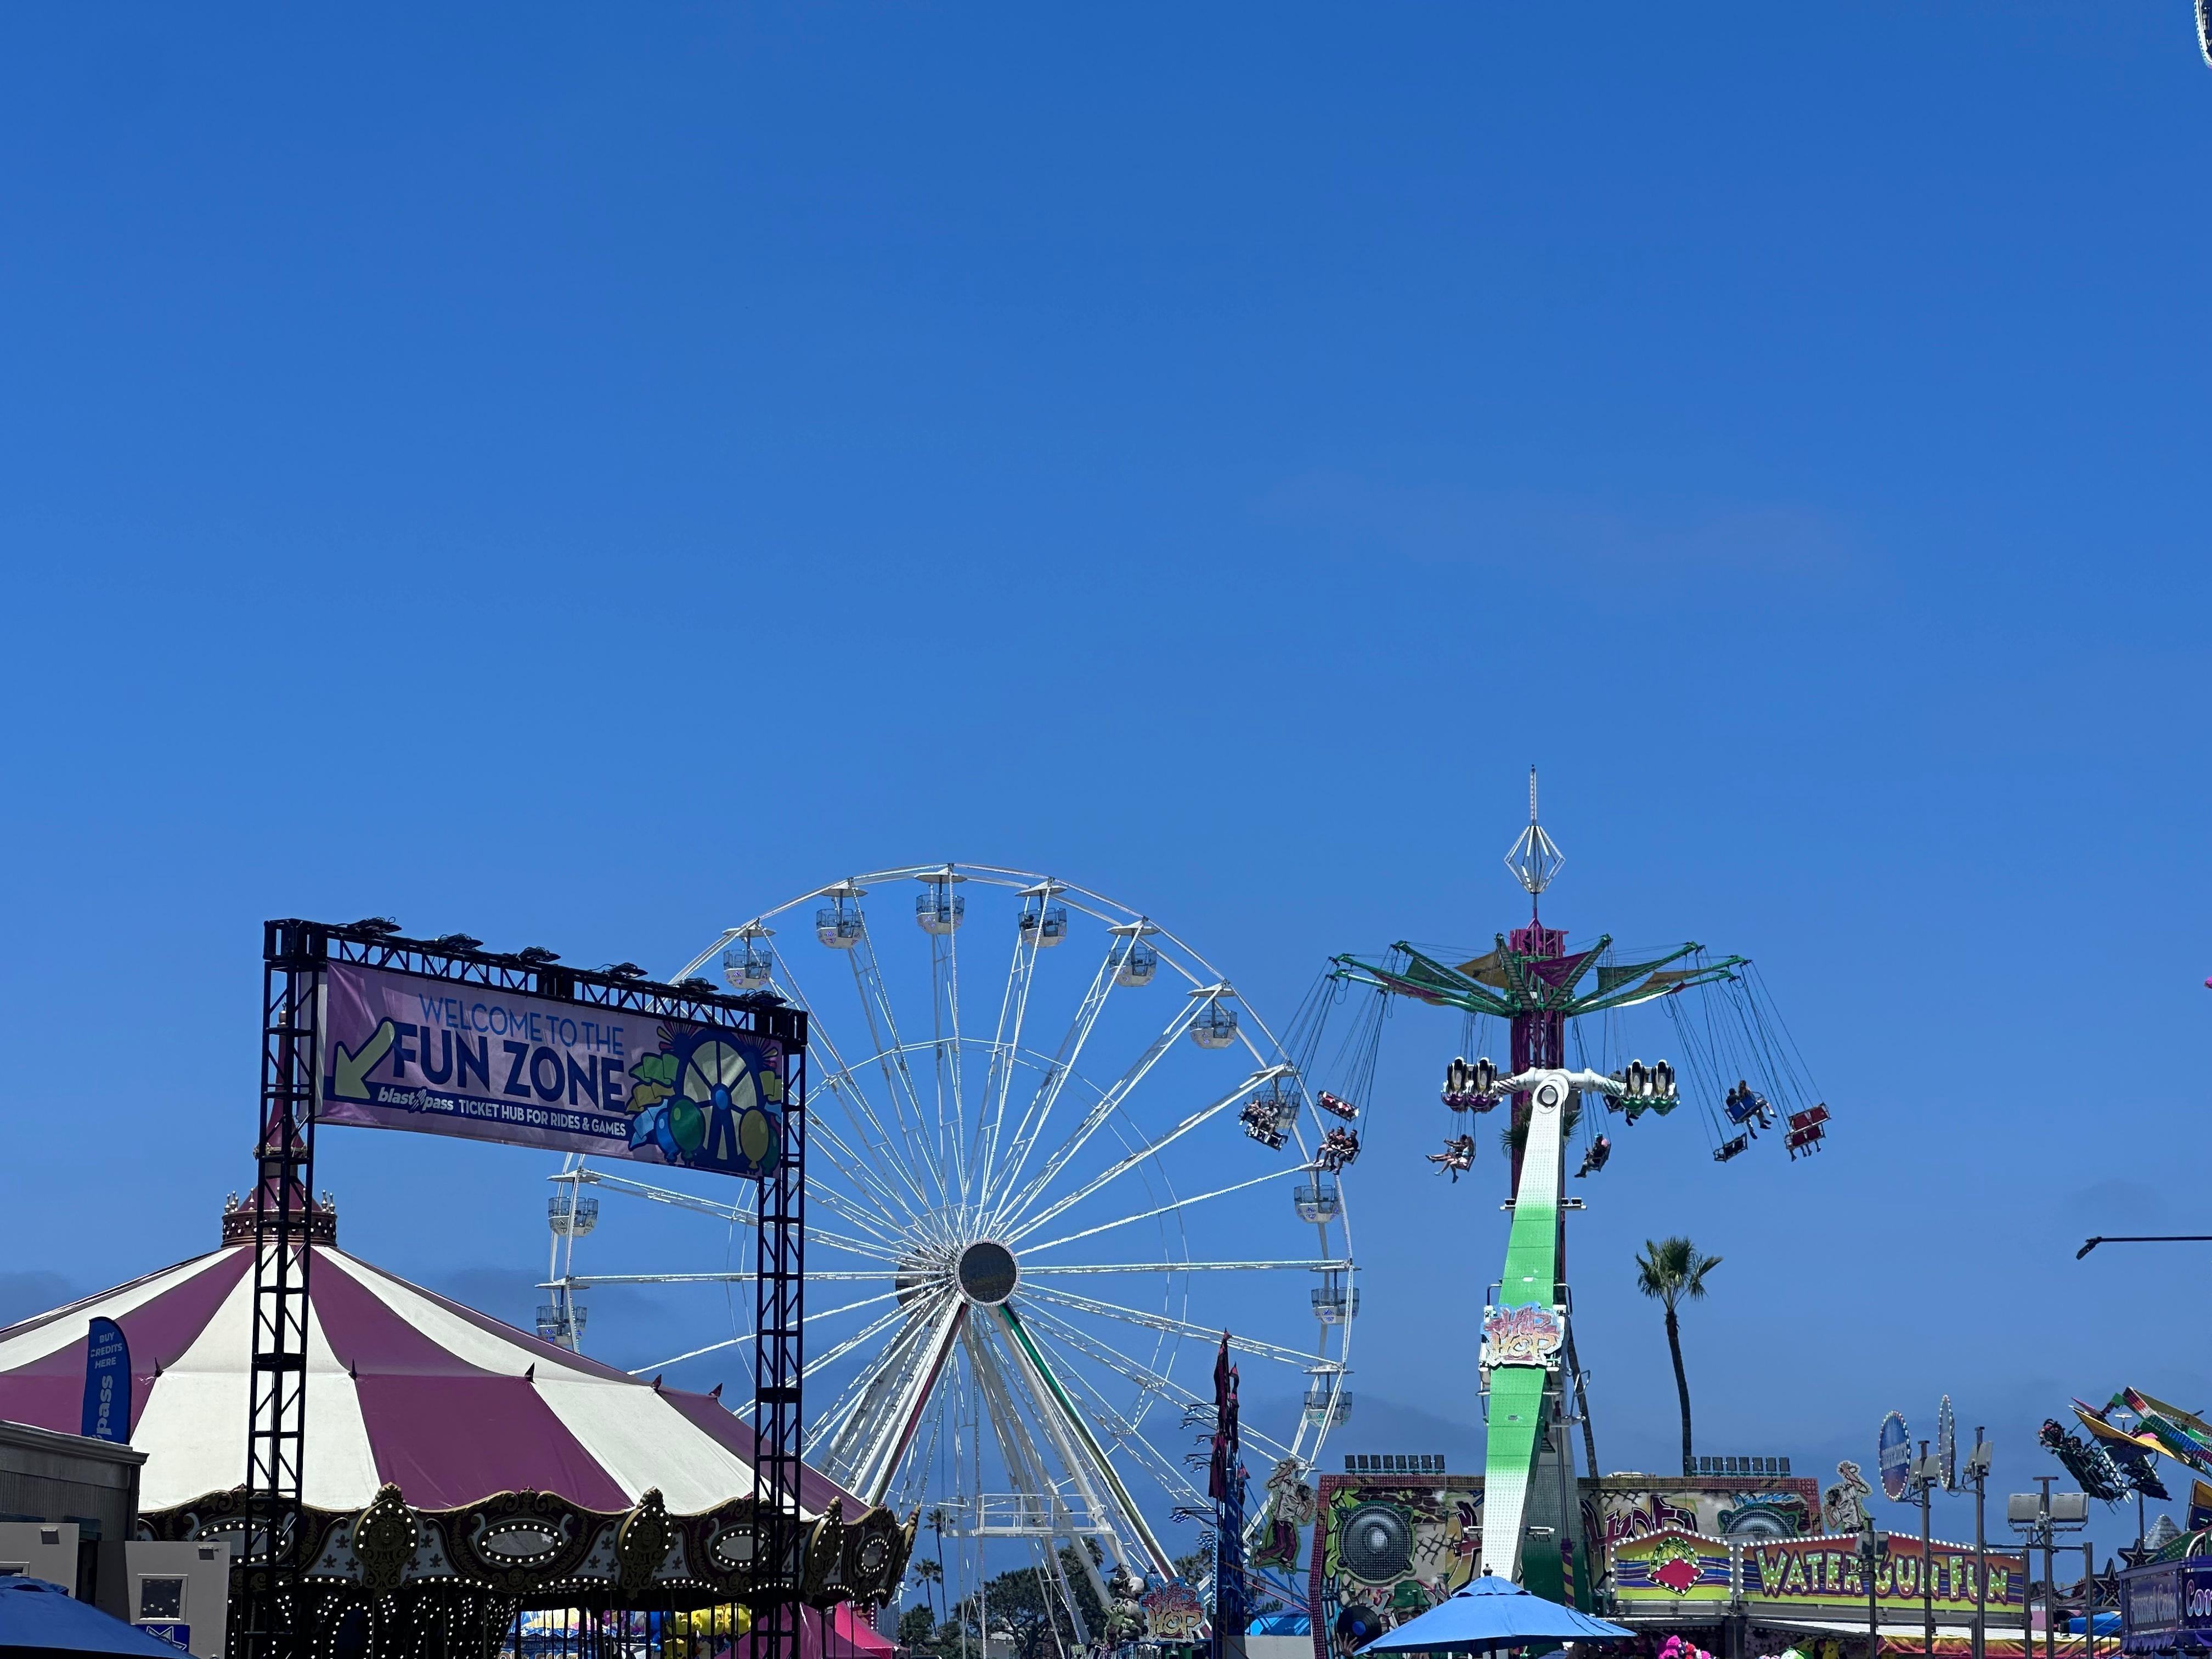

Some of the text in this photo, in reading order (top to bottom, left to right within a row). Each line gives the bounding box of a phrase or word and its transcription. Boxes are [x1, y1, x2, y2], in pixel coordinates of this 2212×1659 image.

[418, 993, 624, 1056] WELCOME TO THE
[393, 1021, 626, 1115] FUN ZONE
[459, 1099, 499, 1118] TICKET
[501, 1105, 525, 1121] HUB
[527, 1109, 549, 1125] FOR
[550, 1112, 580, 1130] RIDES
[582, 1116, 590, 1131] &
[591, 1119, 627, 1137] GAMES
[89, 1342, 123, 1358] CREDITS
[99, 1331, 115, 1344] BUY
[1488, 1331, 1559, 1365] HOP
[94, 1356, 117, 1369] HERE
[96, 1374, 114, 1436] pass
[1754, 1547, 1864, 1596] WATER
[2186, 1578, 2212, 1618] Cor
[1146, 1607, 1202, 1641] HOP
